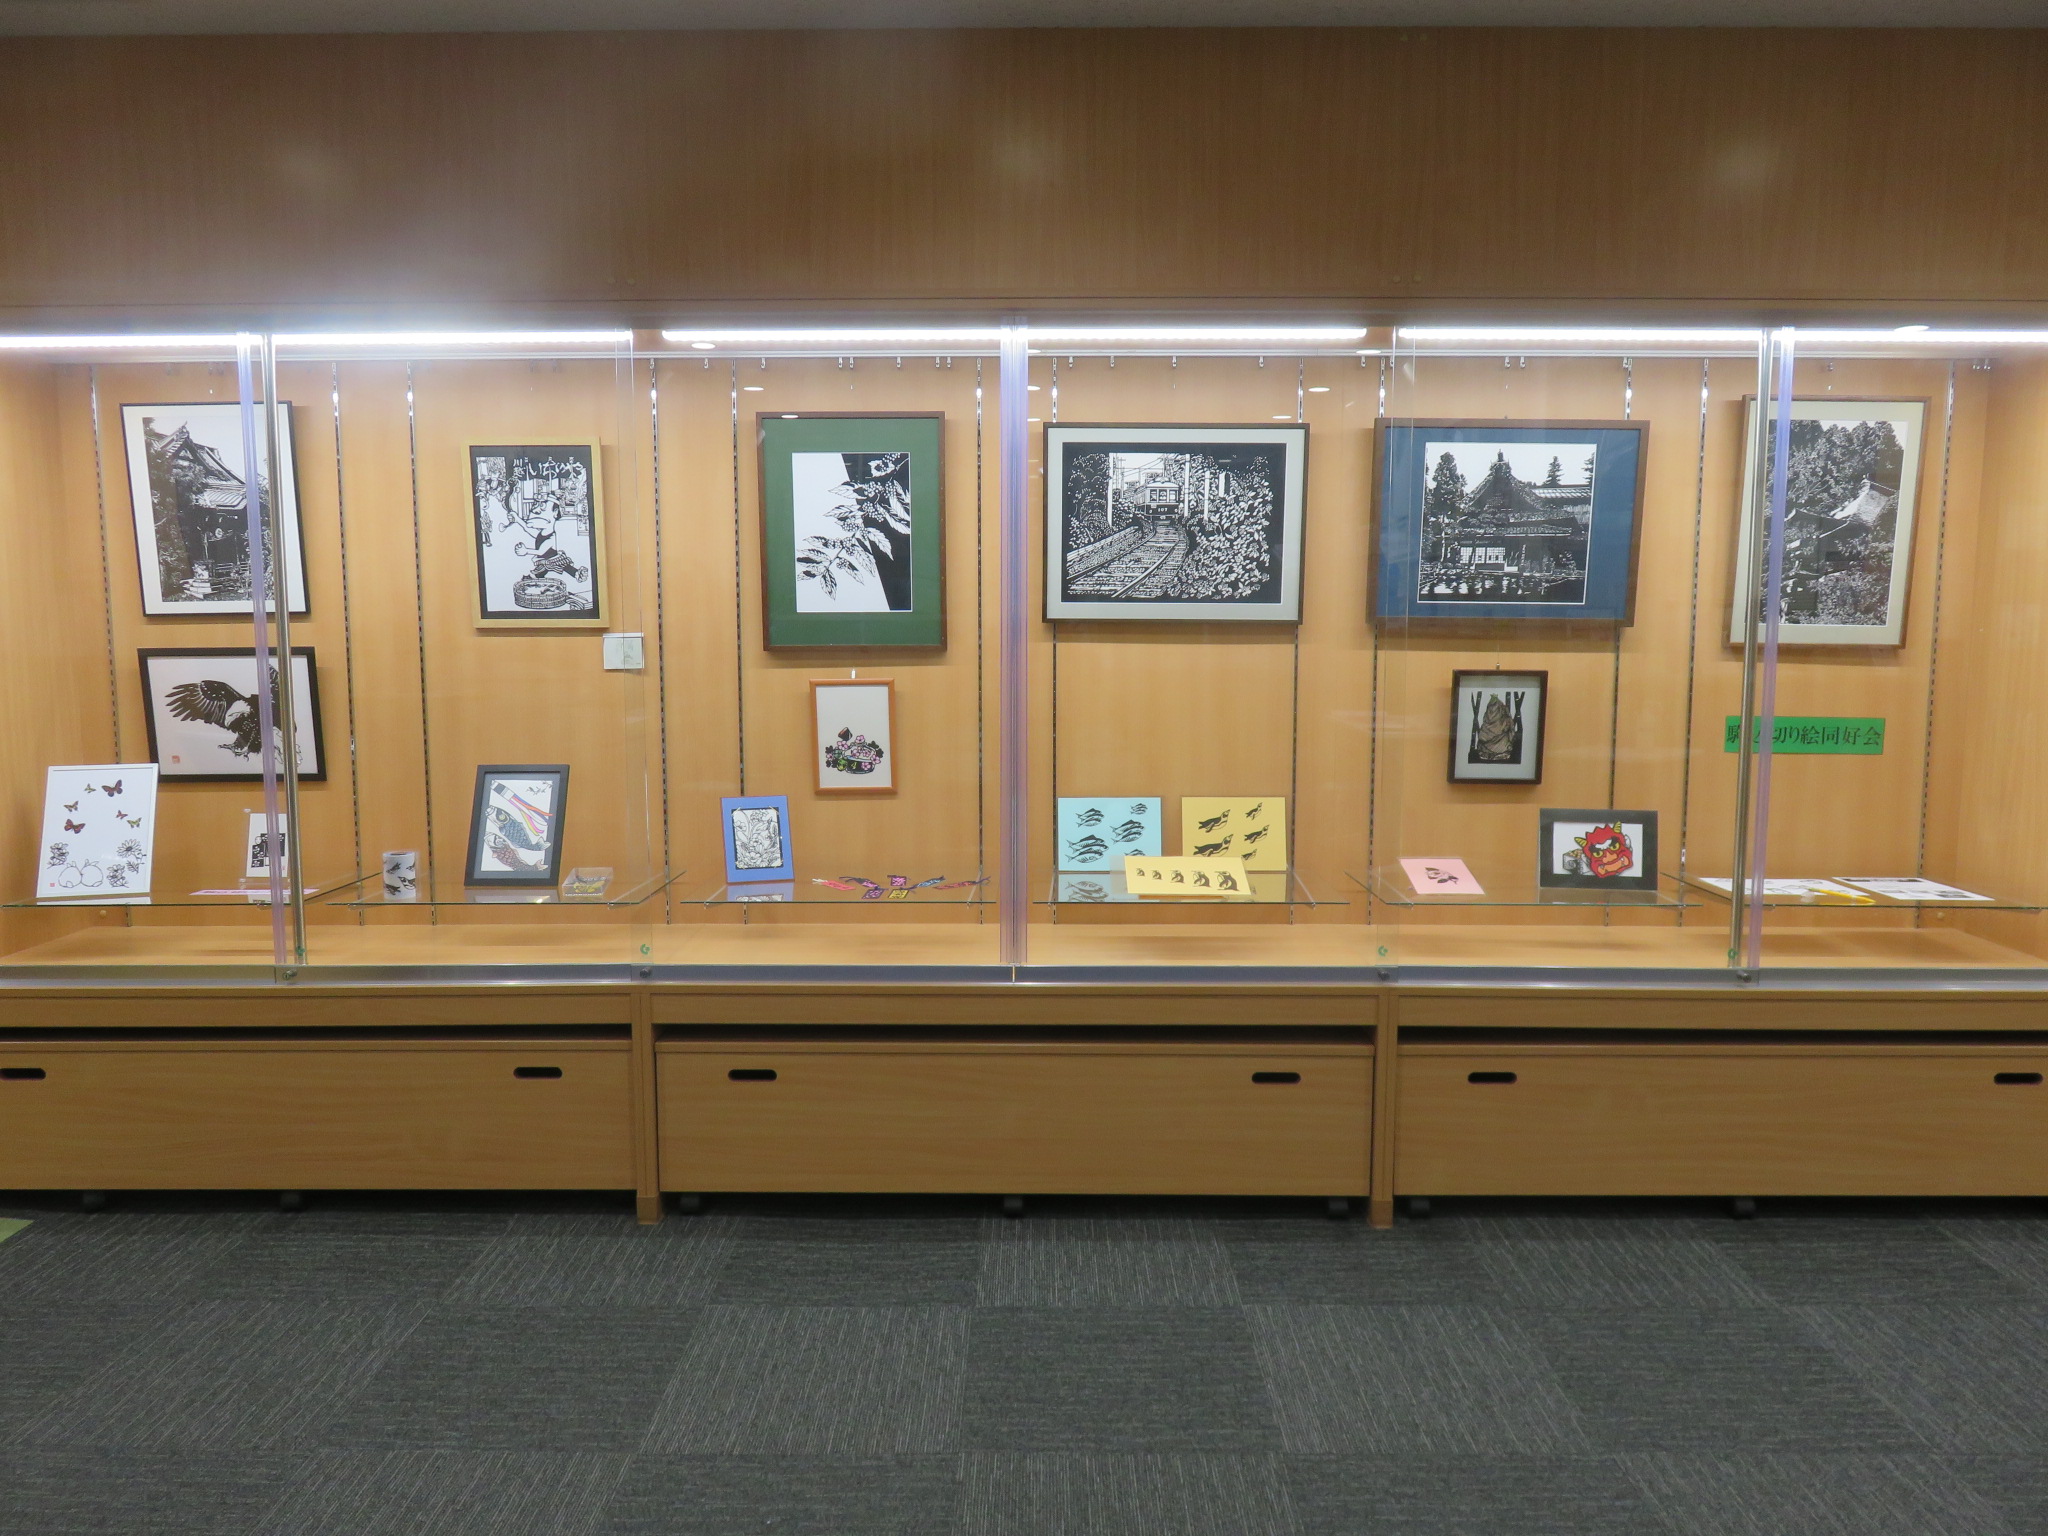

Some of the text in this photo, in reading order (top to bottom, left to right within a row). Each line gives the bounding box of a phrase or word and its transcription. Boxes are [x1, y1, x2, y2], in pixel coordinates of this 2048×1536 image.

[1727, 725, 1882, 746] 駒切り絵同好会
